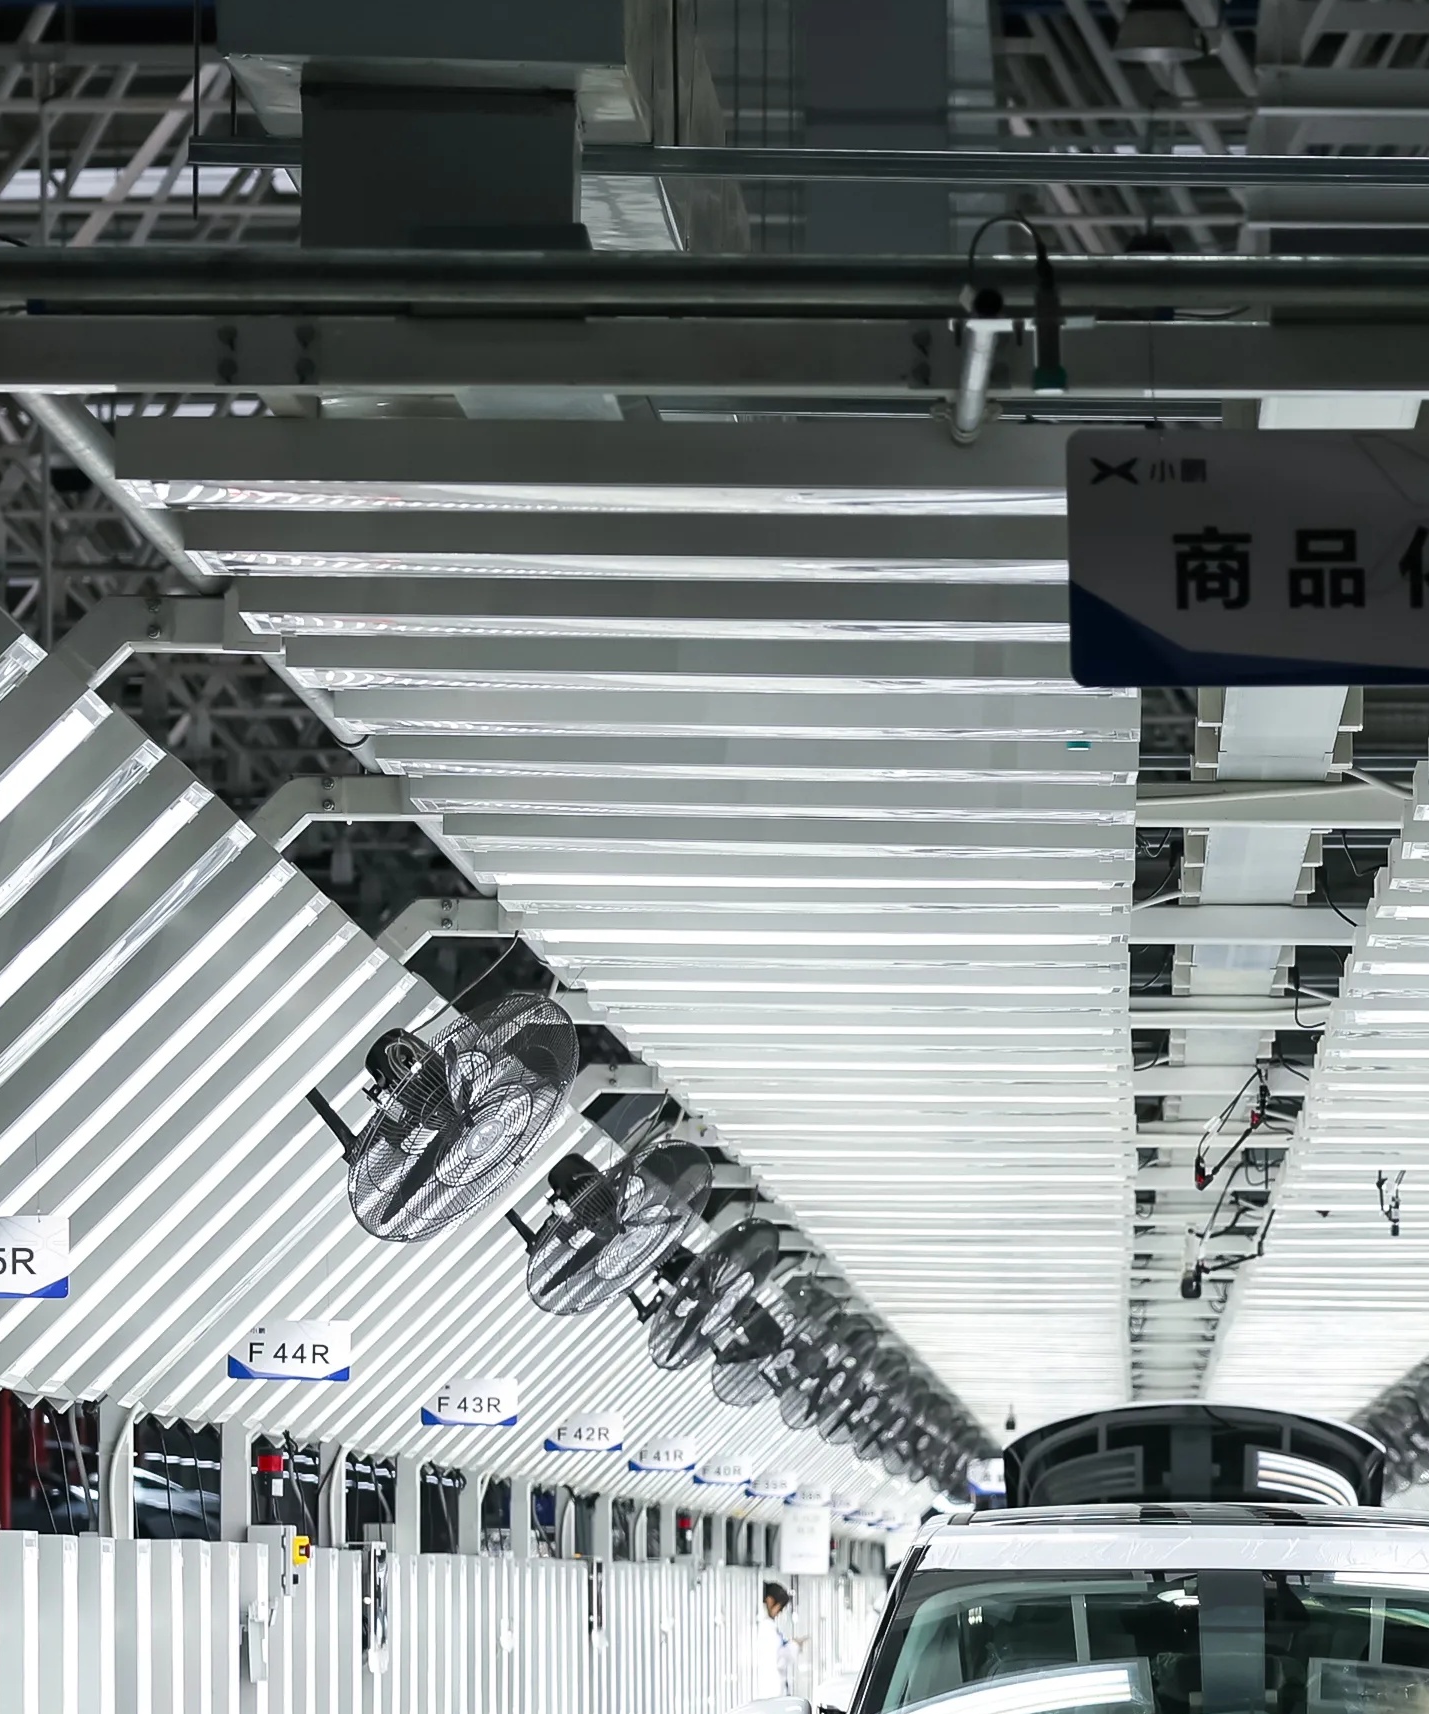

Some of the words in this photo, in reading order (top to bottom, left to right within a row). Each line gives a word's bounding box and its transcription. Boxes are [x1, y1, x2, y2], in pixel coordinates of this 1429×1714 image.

[248, 1342, 265, 1363] F
[272, 1342, 330, 1364] 44R
[437, 1396, 450, 1413] F
[456, 1396, 502, 1414] 43R
[557, 1427, 568, 1441] F
[573, 1426, 610, 1441] 42R
[639, 1450, 648, 1462] F
[653, 1450, 684, 1462] 41R
